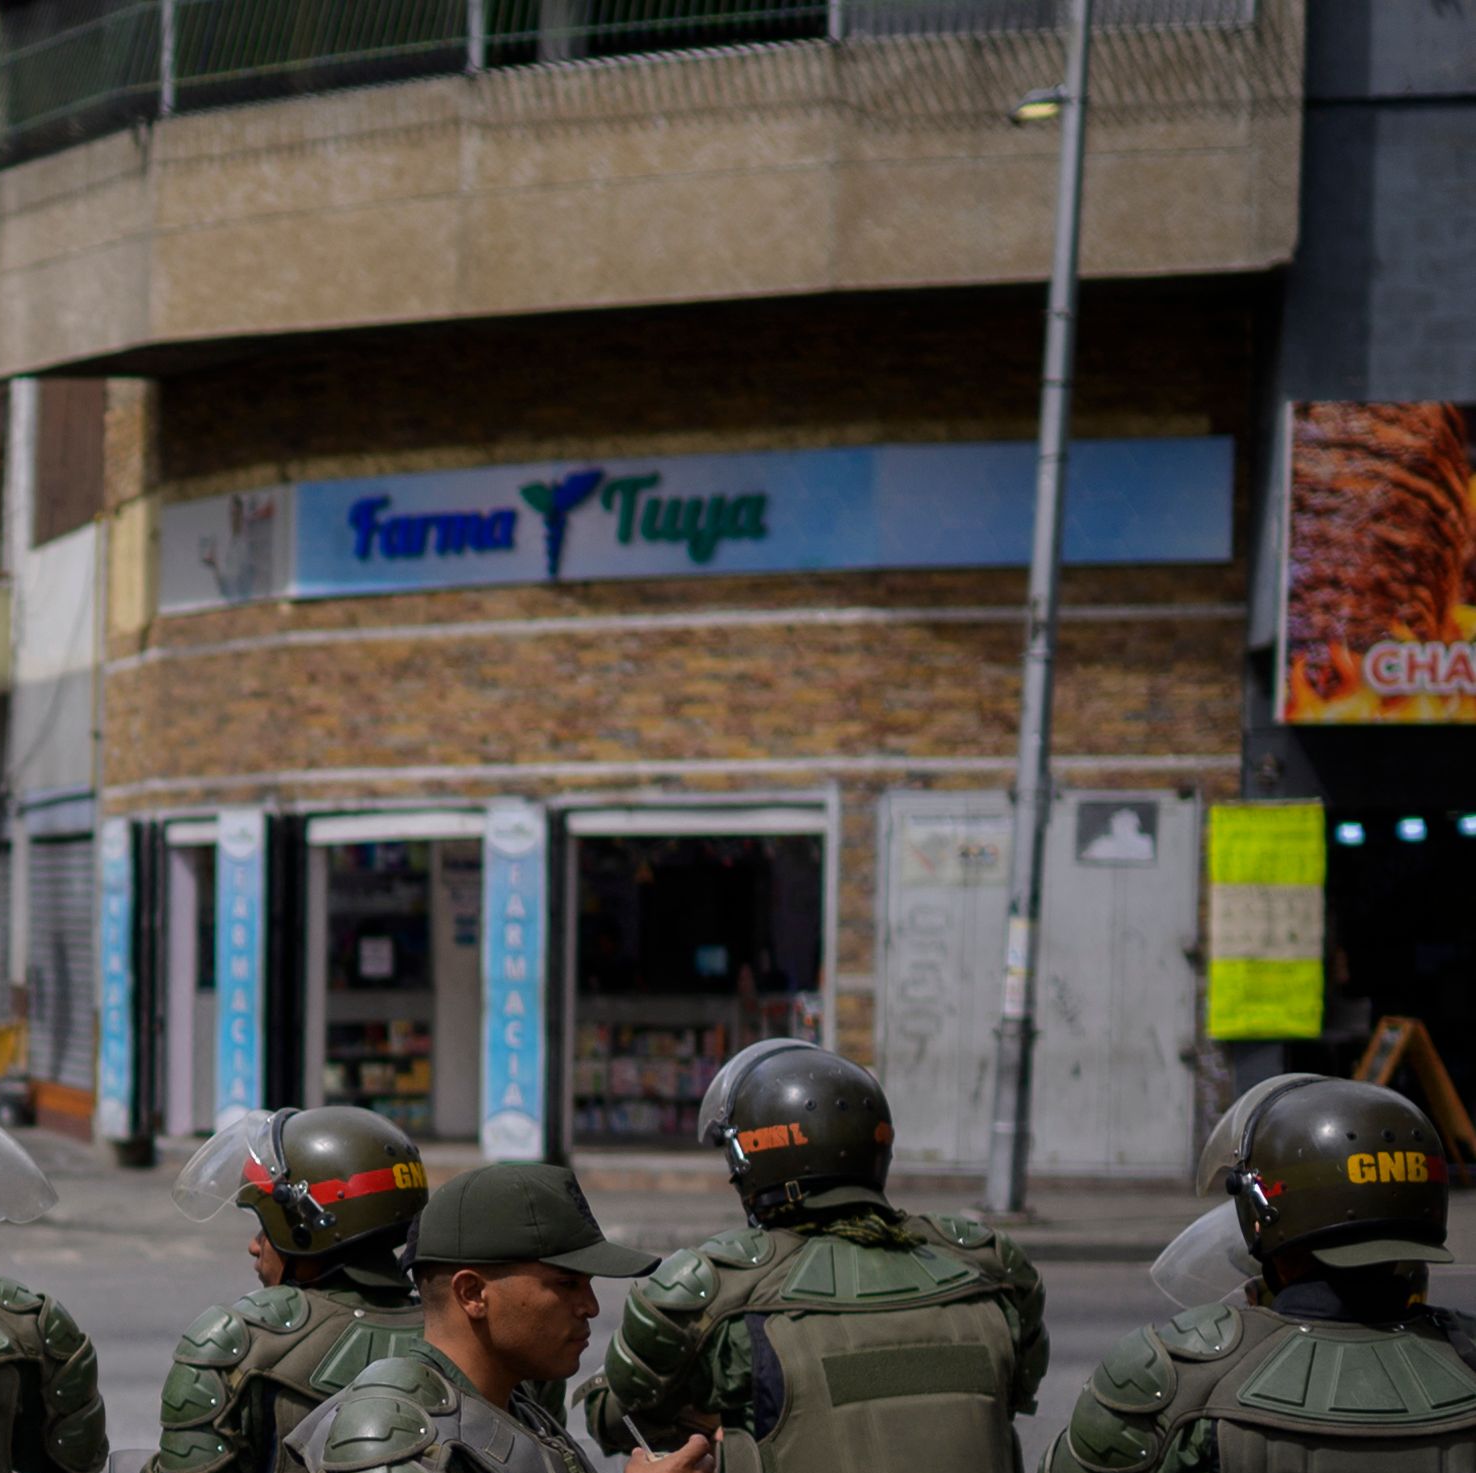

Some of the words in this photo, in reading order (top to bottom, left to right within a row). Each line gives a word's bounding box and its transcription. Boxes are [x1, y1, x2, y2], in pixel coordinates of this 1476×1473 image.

[350, 495, 518, 561] Farma
[601, 470, 768, 565] Tuya
[1346, 1150, 1430, 1185] GNB
